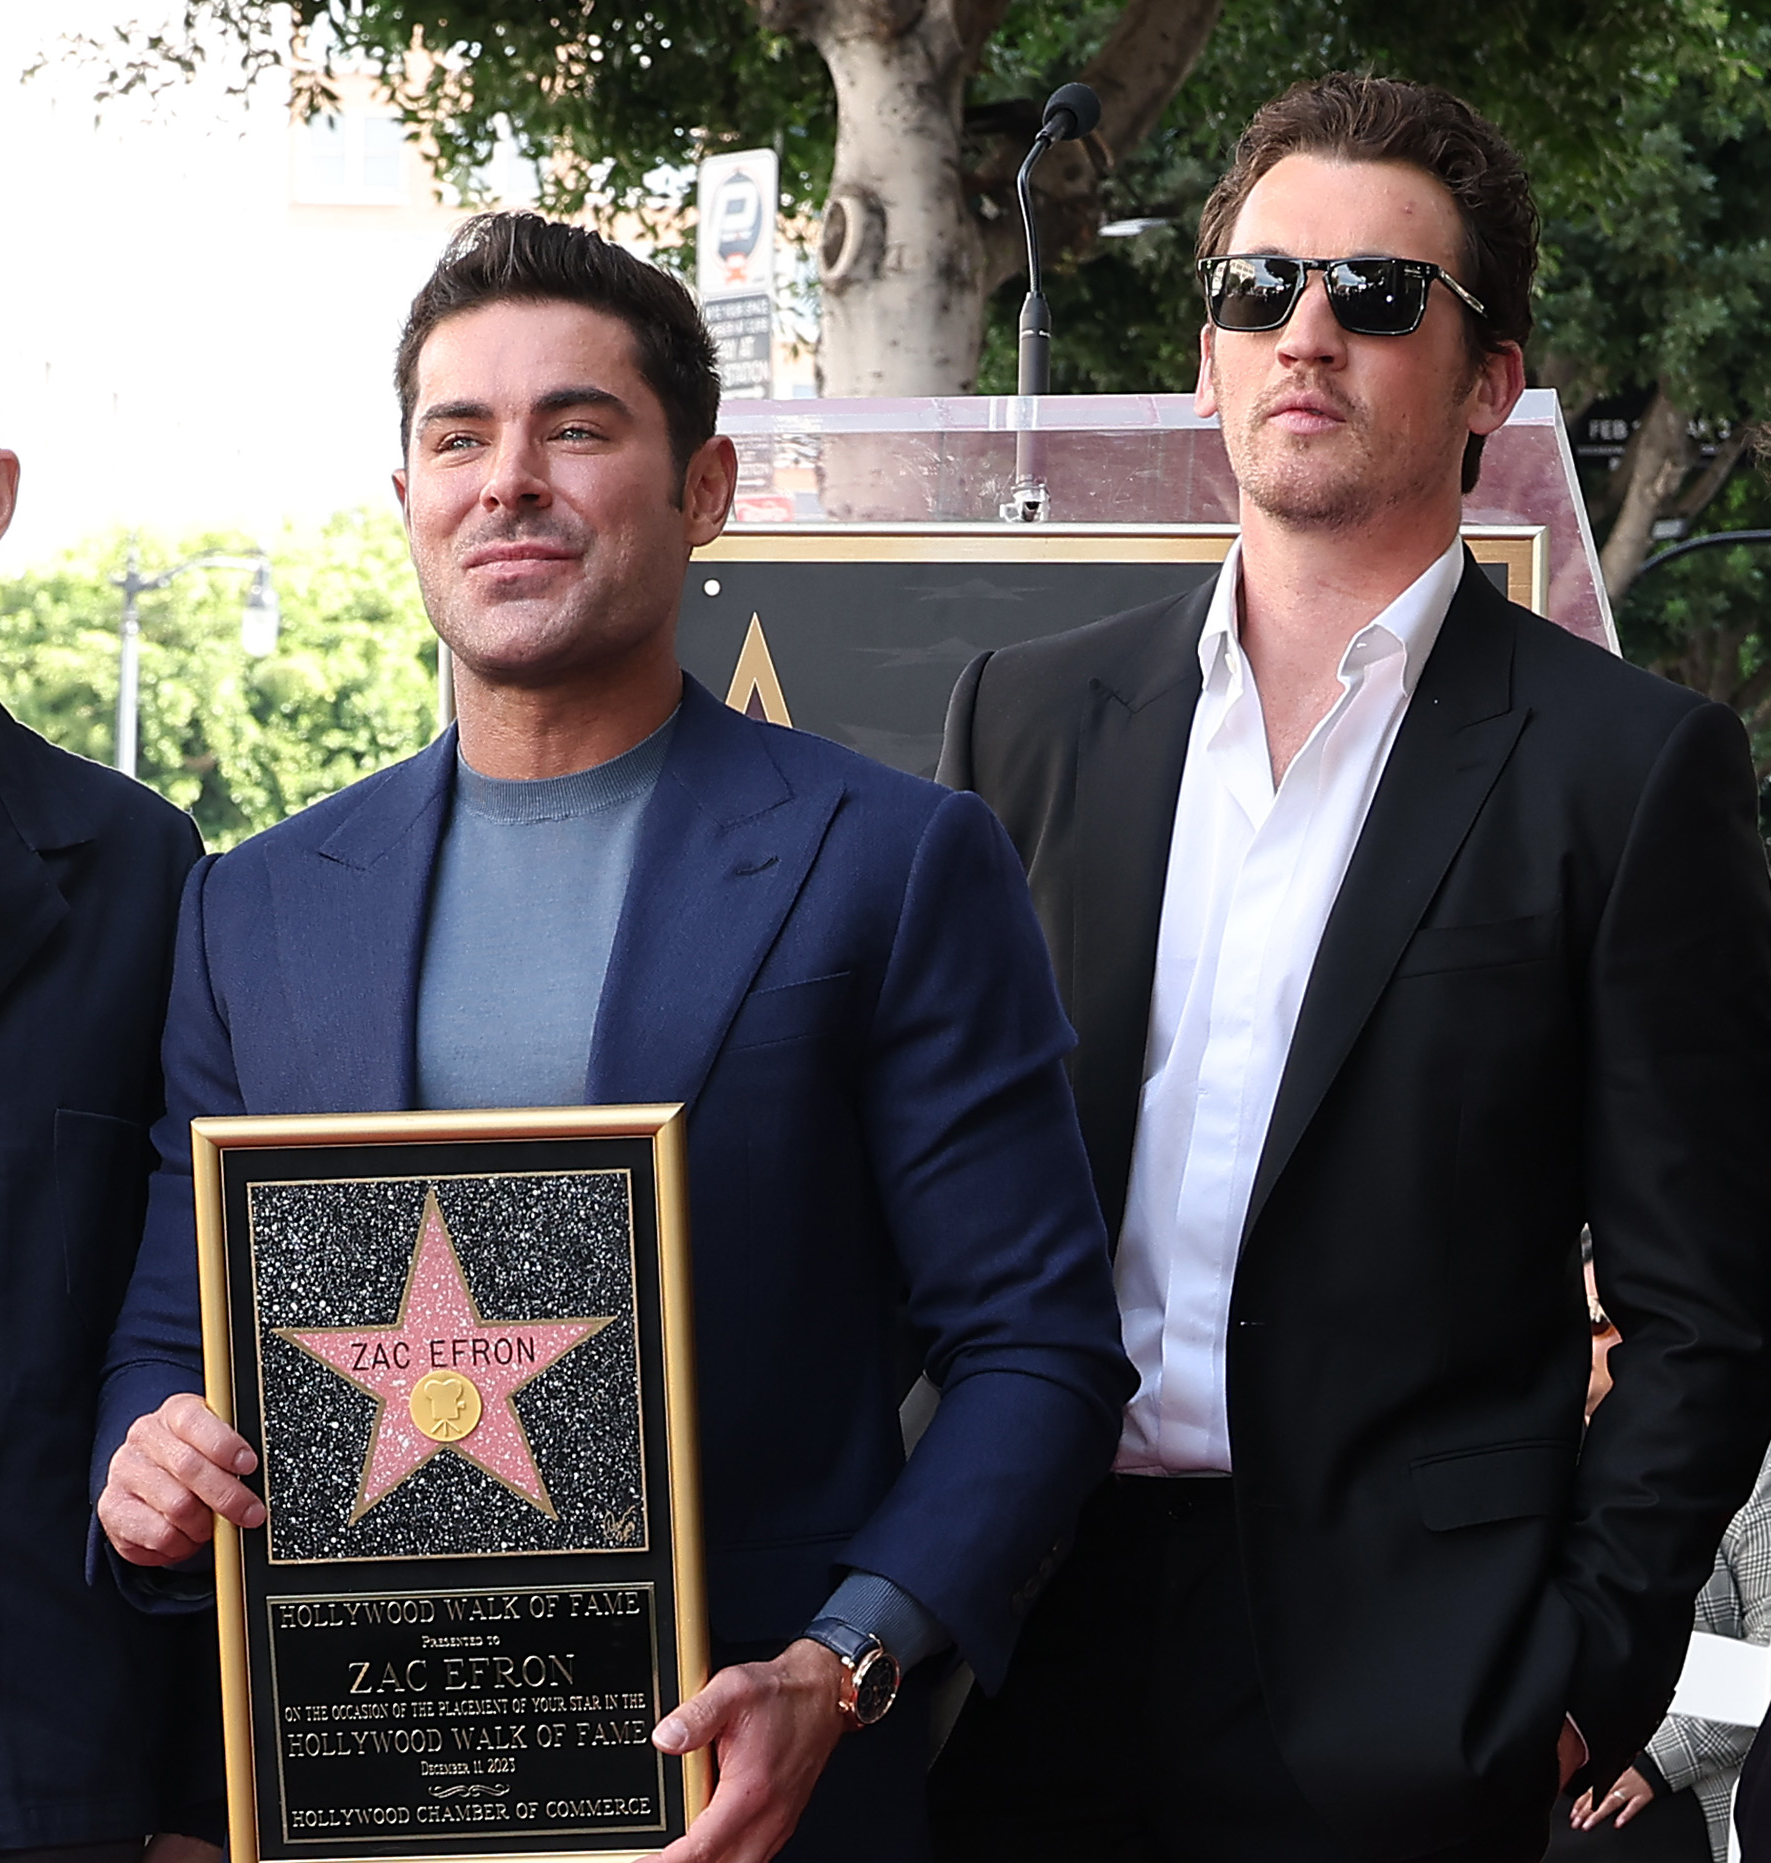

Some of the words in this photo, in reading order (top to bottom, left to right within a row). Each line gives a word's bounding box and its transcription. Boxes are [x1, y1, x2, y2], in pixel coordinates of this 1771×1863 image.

[351, 1341, 411, 1372] ZAC
[429, 1336, 536, 1368] EFRON
[279, 1599, 436, 1629] HOLLYWOOD
[443, 1596, 521, 1621] WALK
[529, 1594, 560, 1619] OF
[568, 1591, 641, 1618] FAME
[348, 1659, 428, 1694] ZAC
[443, 1653, 575, 1691] EFRON
[284, 1705, 302, 1723] ON
[305, 1704, 329, 1722] THE
[331, 1702, 389, 1721] OCCASION
[392, 1701, 407, 1719] OF
[410, 1701, 435, 1718] THE
[438, 1698, 509, 1717] PLACEMENT
[511, 1697, 528, 1714] OF
[531, 1696, 568, 1713] YOUR
[569, 1694, 602, 1712] STAR
[604, 1693, 619, 1711] IN
[622, 1692, 647, 1710] THE
[287, 1728, 443, 1758] HOLLYWOOD
[450, 1724, 529, 1751] WALK
[535, 1722, 567, 1748] OF
[575, 1720, 648, 1747] FAME
[486, 1757, 517, 1774] 2023
[291, 1806, 411, 1828] HOLLYWOOD
[416, 1802, 511, 1823] CHAMBER
[515, 1801, 539, 1820] OF
[545, 1797, 652, 1819] COMMERCE
